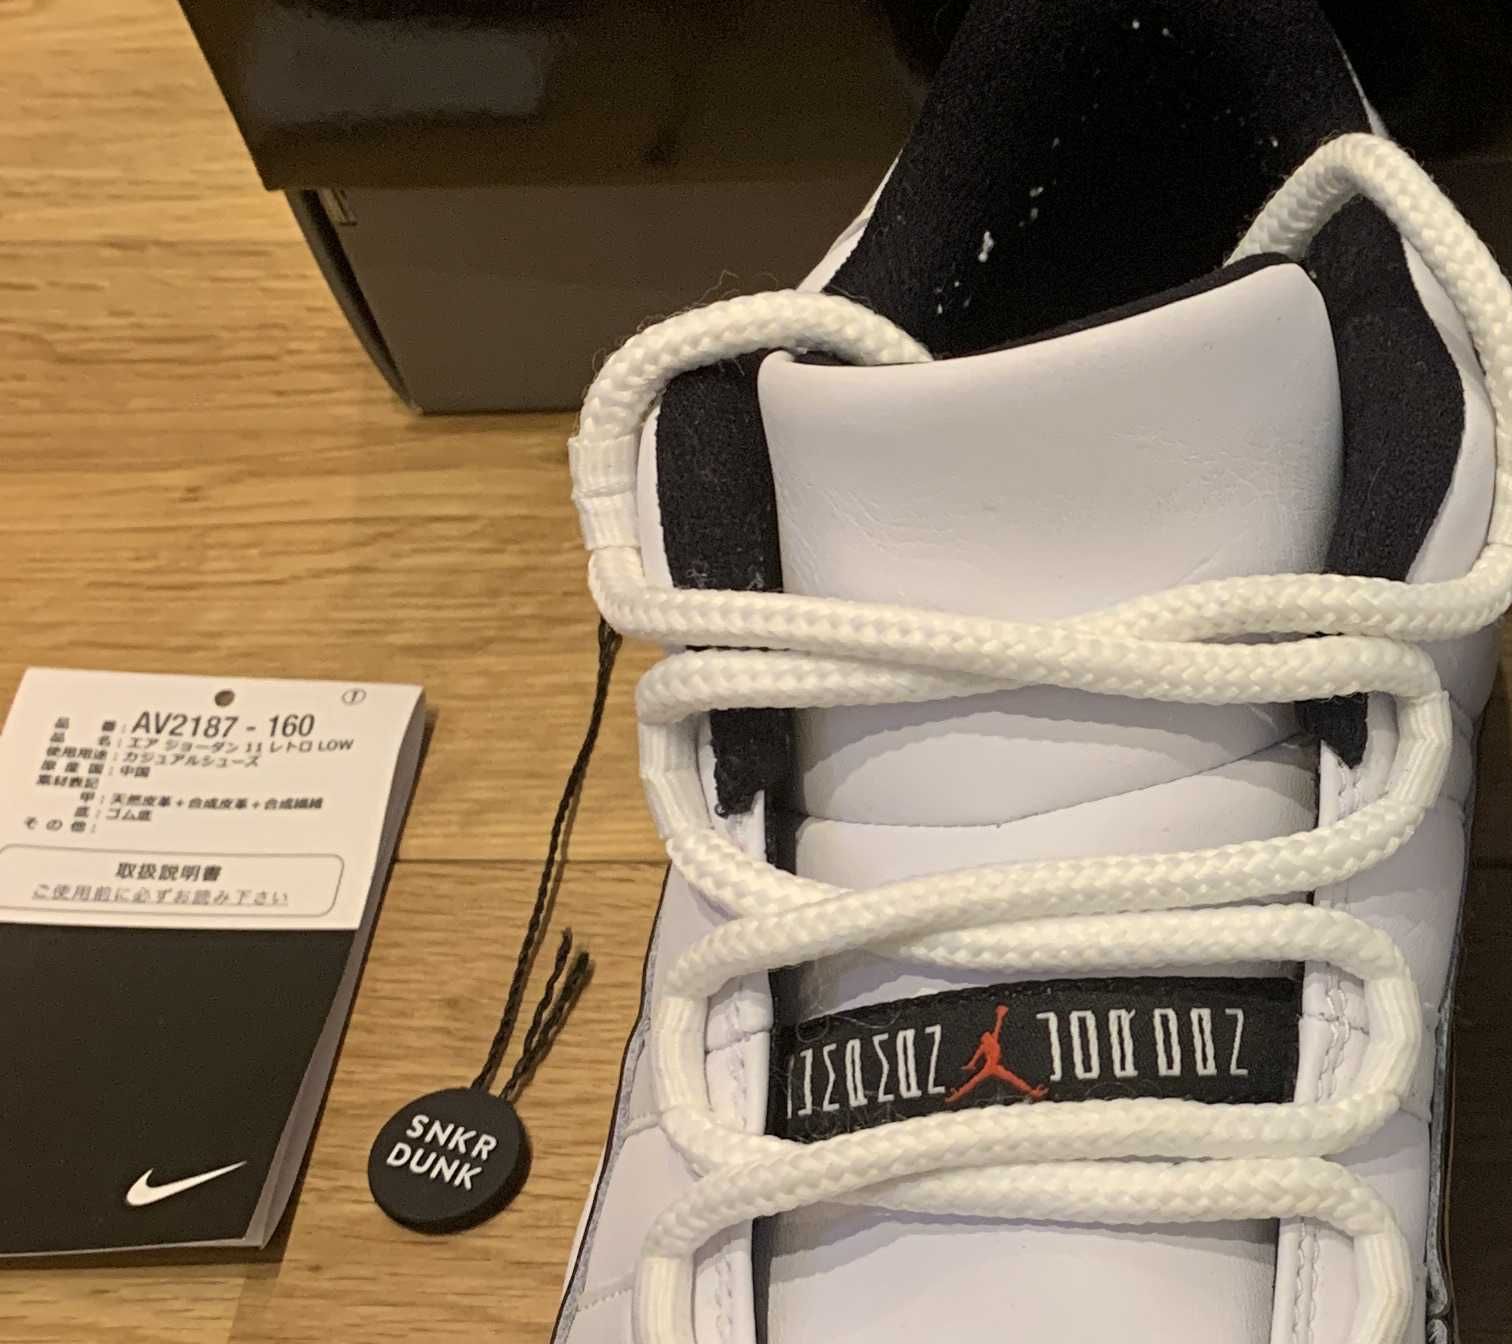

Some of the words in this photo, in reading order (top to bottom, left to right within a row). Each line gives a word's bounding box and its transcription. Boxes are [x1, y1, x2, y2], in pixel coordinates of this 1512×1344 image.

[132, 710, 239, 738] AV2187
[268, 713, 316, 738] 160
[318, 738, 354, 752] LOW
[115, 860, 222, 882] 取扱説明書
[406, 1114, 497, 1161] SNKR
[386, 1142, 482, 1190] DUNK
